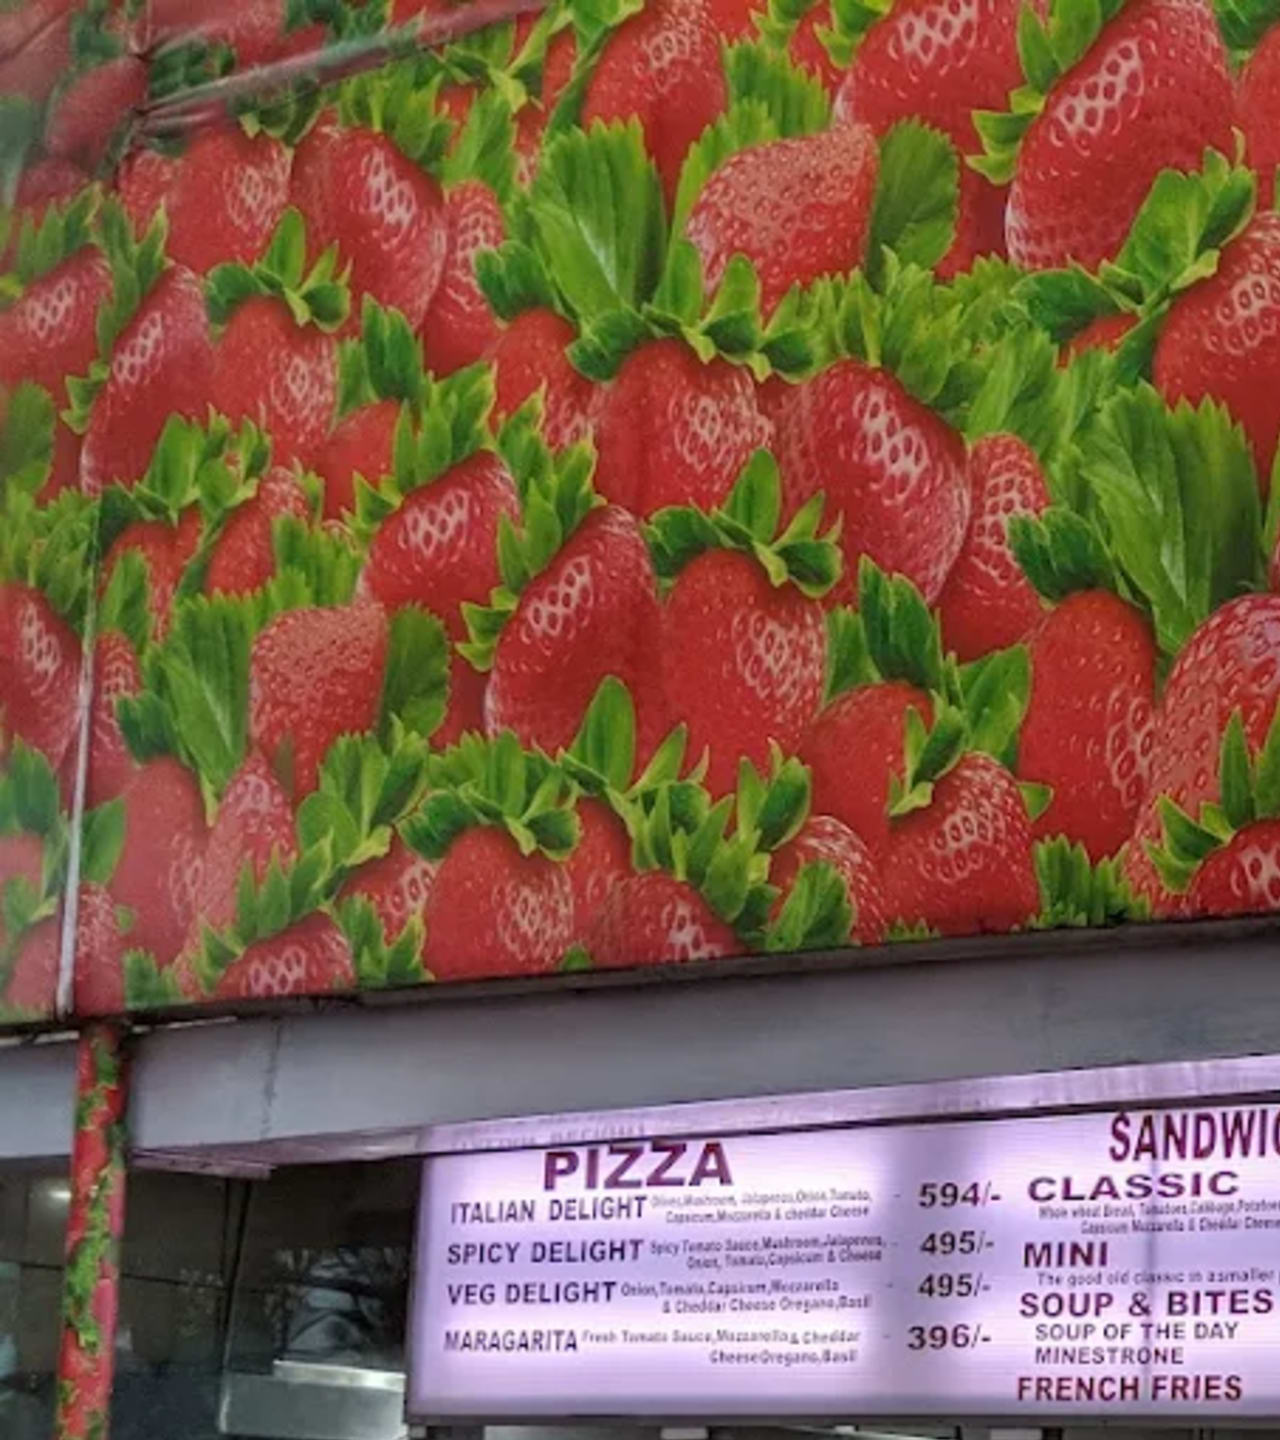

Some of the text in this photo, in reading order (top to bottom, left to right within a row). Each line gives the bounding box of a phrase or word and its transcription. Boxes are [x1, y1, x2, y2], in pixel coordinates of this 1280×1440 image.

[544, 1142, 733, 1190] PIZZA
[918, 1181, 1000, 1208] 594/-
[1028, 1172, 1239, 1202] CLASSIC
[451, 1200, 535, 1224] ITALIAN
[550, 1195, 647, 1221] DELIGHT
[447, 1241, 520, 1265] SPICY
[531, 1239, 644, 1263] DELIGHT
[920, 1231, 994, 1255] 495/-
[1024, 1242, 1108, 1268] MINI
[448, 1284, 495, 1304] VEG
[506, 1282, 616, 1303] DELIGHT
[918, 1274, 990, 1297] 495/-
[1020, 1289, 1273, 1317] SOUP & BITES
[445, 1330, 577, 1351] MARAGARITA
[908, 1324, 991, 1350] 396/-
[1035, 1346, 1183, 1365] MINESTRONE
[1017, 1376, 1242, 1401] FRENCH FRIES
